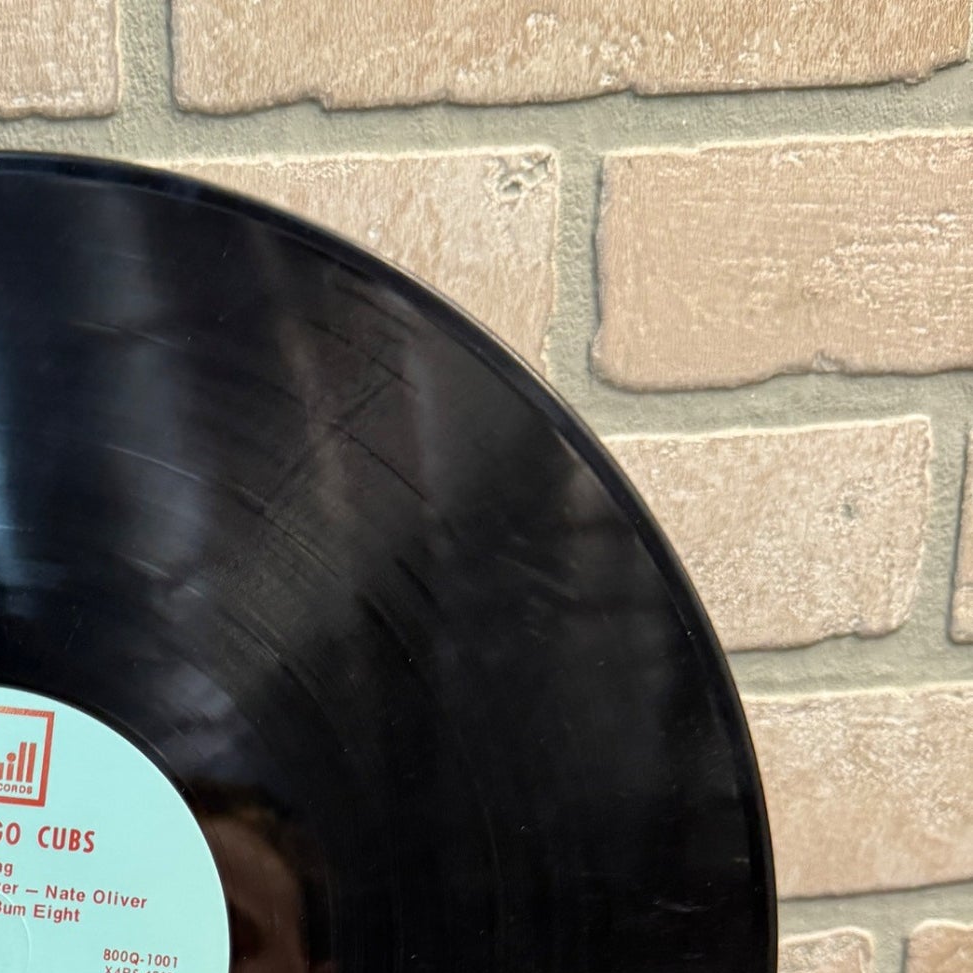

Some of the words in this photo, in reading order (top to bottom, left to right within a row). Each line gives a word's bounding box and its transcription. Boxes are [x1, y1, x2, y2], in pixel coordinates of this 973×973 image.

[37, 825, 96, 853] CUBS
[45, 884, 86, 902] Nate
[93, 889, 148, 908] Oliver
[33, 904, 81, 924] Eight
